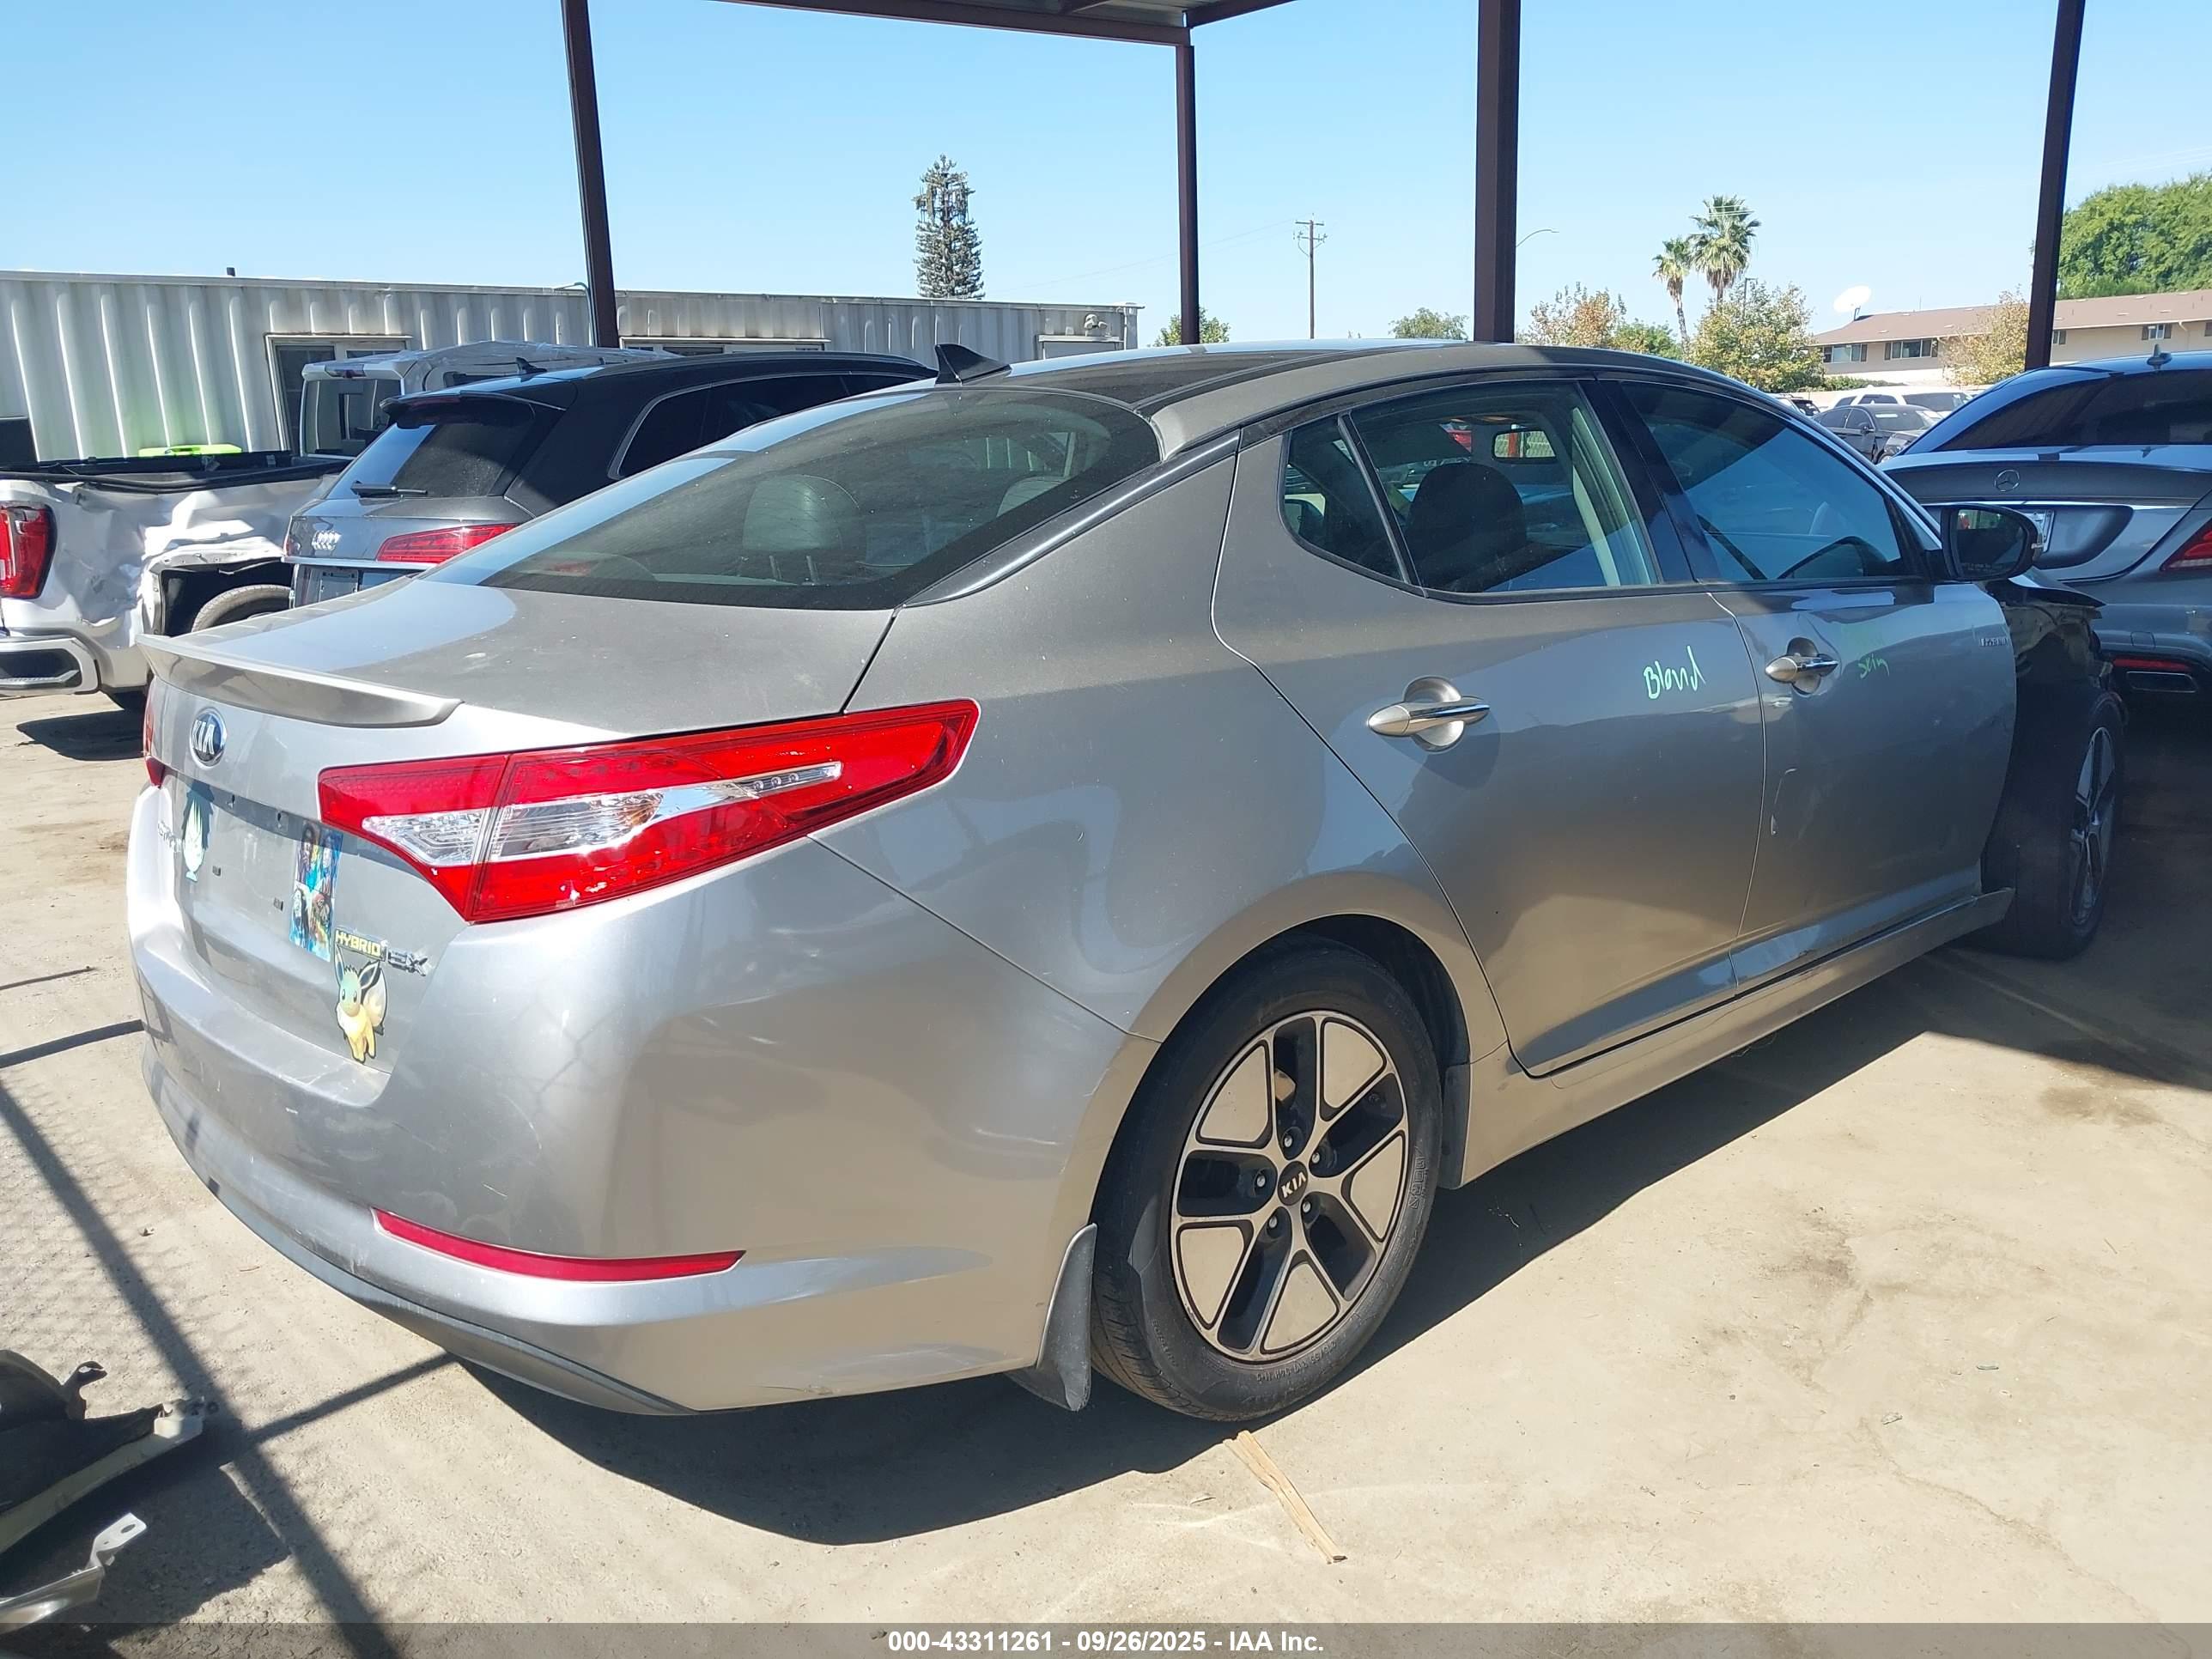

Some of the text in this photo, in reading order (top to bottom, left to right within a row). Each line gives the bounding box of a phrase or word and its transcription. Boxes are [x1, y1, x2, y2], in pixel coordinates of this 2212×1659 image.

[191, 719, 216, 755] KIA
[335, 929, 428, 977] HYBRID EX
[1281, 1171, 1307, 1199] KIA
